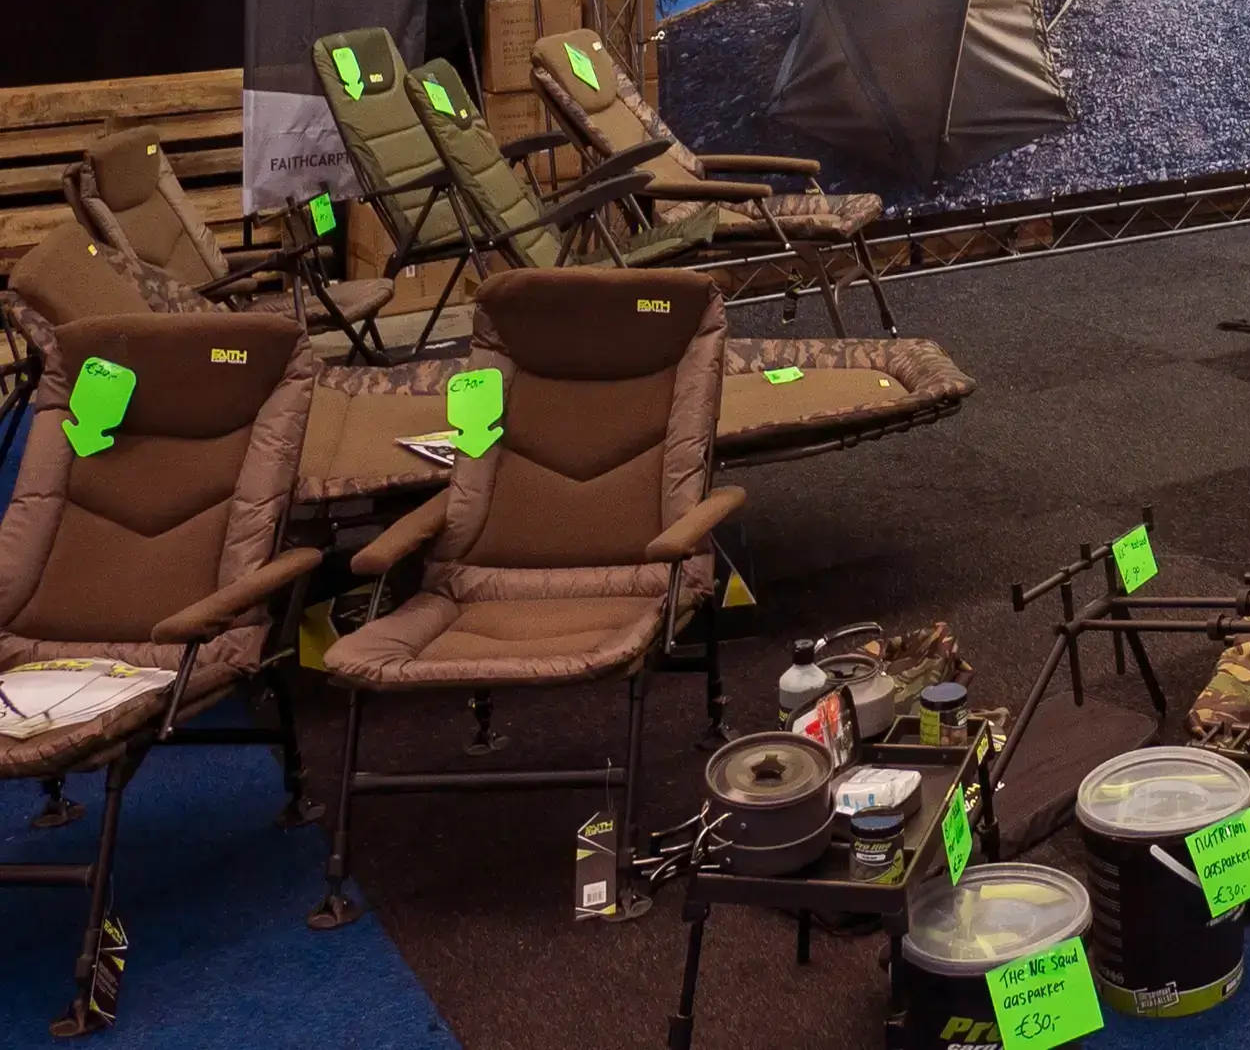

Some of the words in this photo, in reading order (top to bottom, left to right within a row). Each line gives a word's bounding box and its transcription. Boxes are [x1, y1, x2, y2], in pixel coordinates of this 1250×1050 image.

[637, 299, 671, 311] FAITH
[211, 348, 248, 361] FAITH
[1029, 958, 1047, 976] NG
